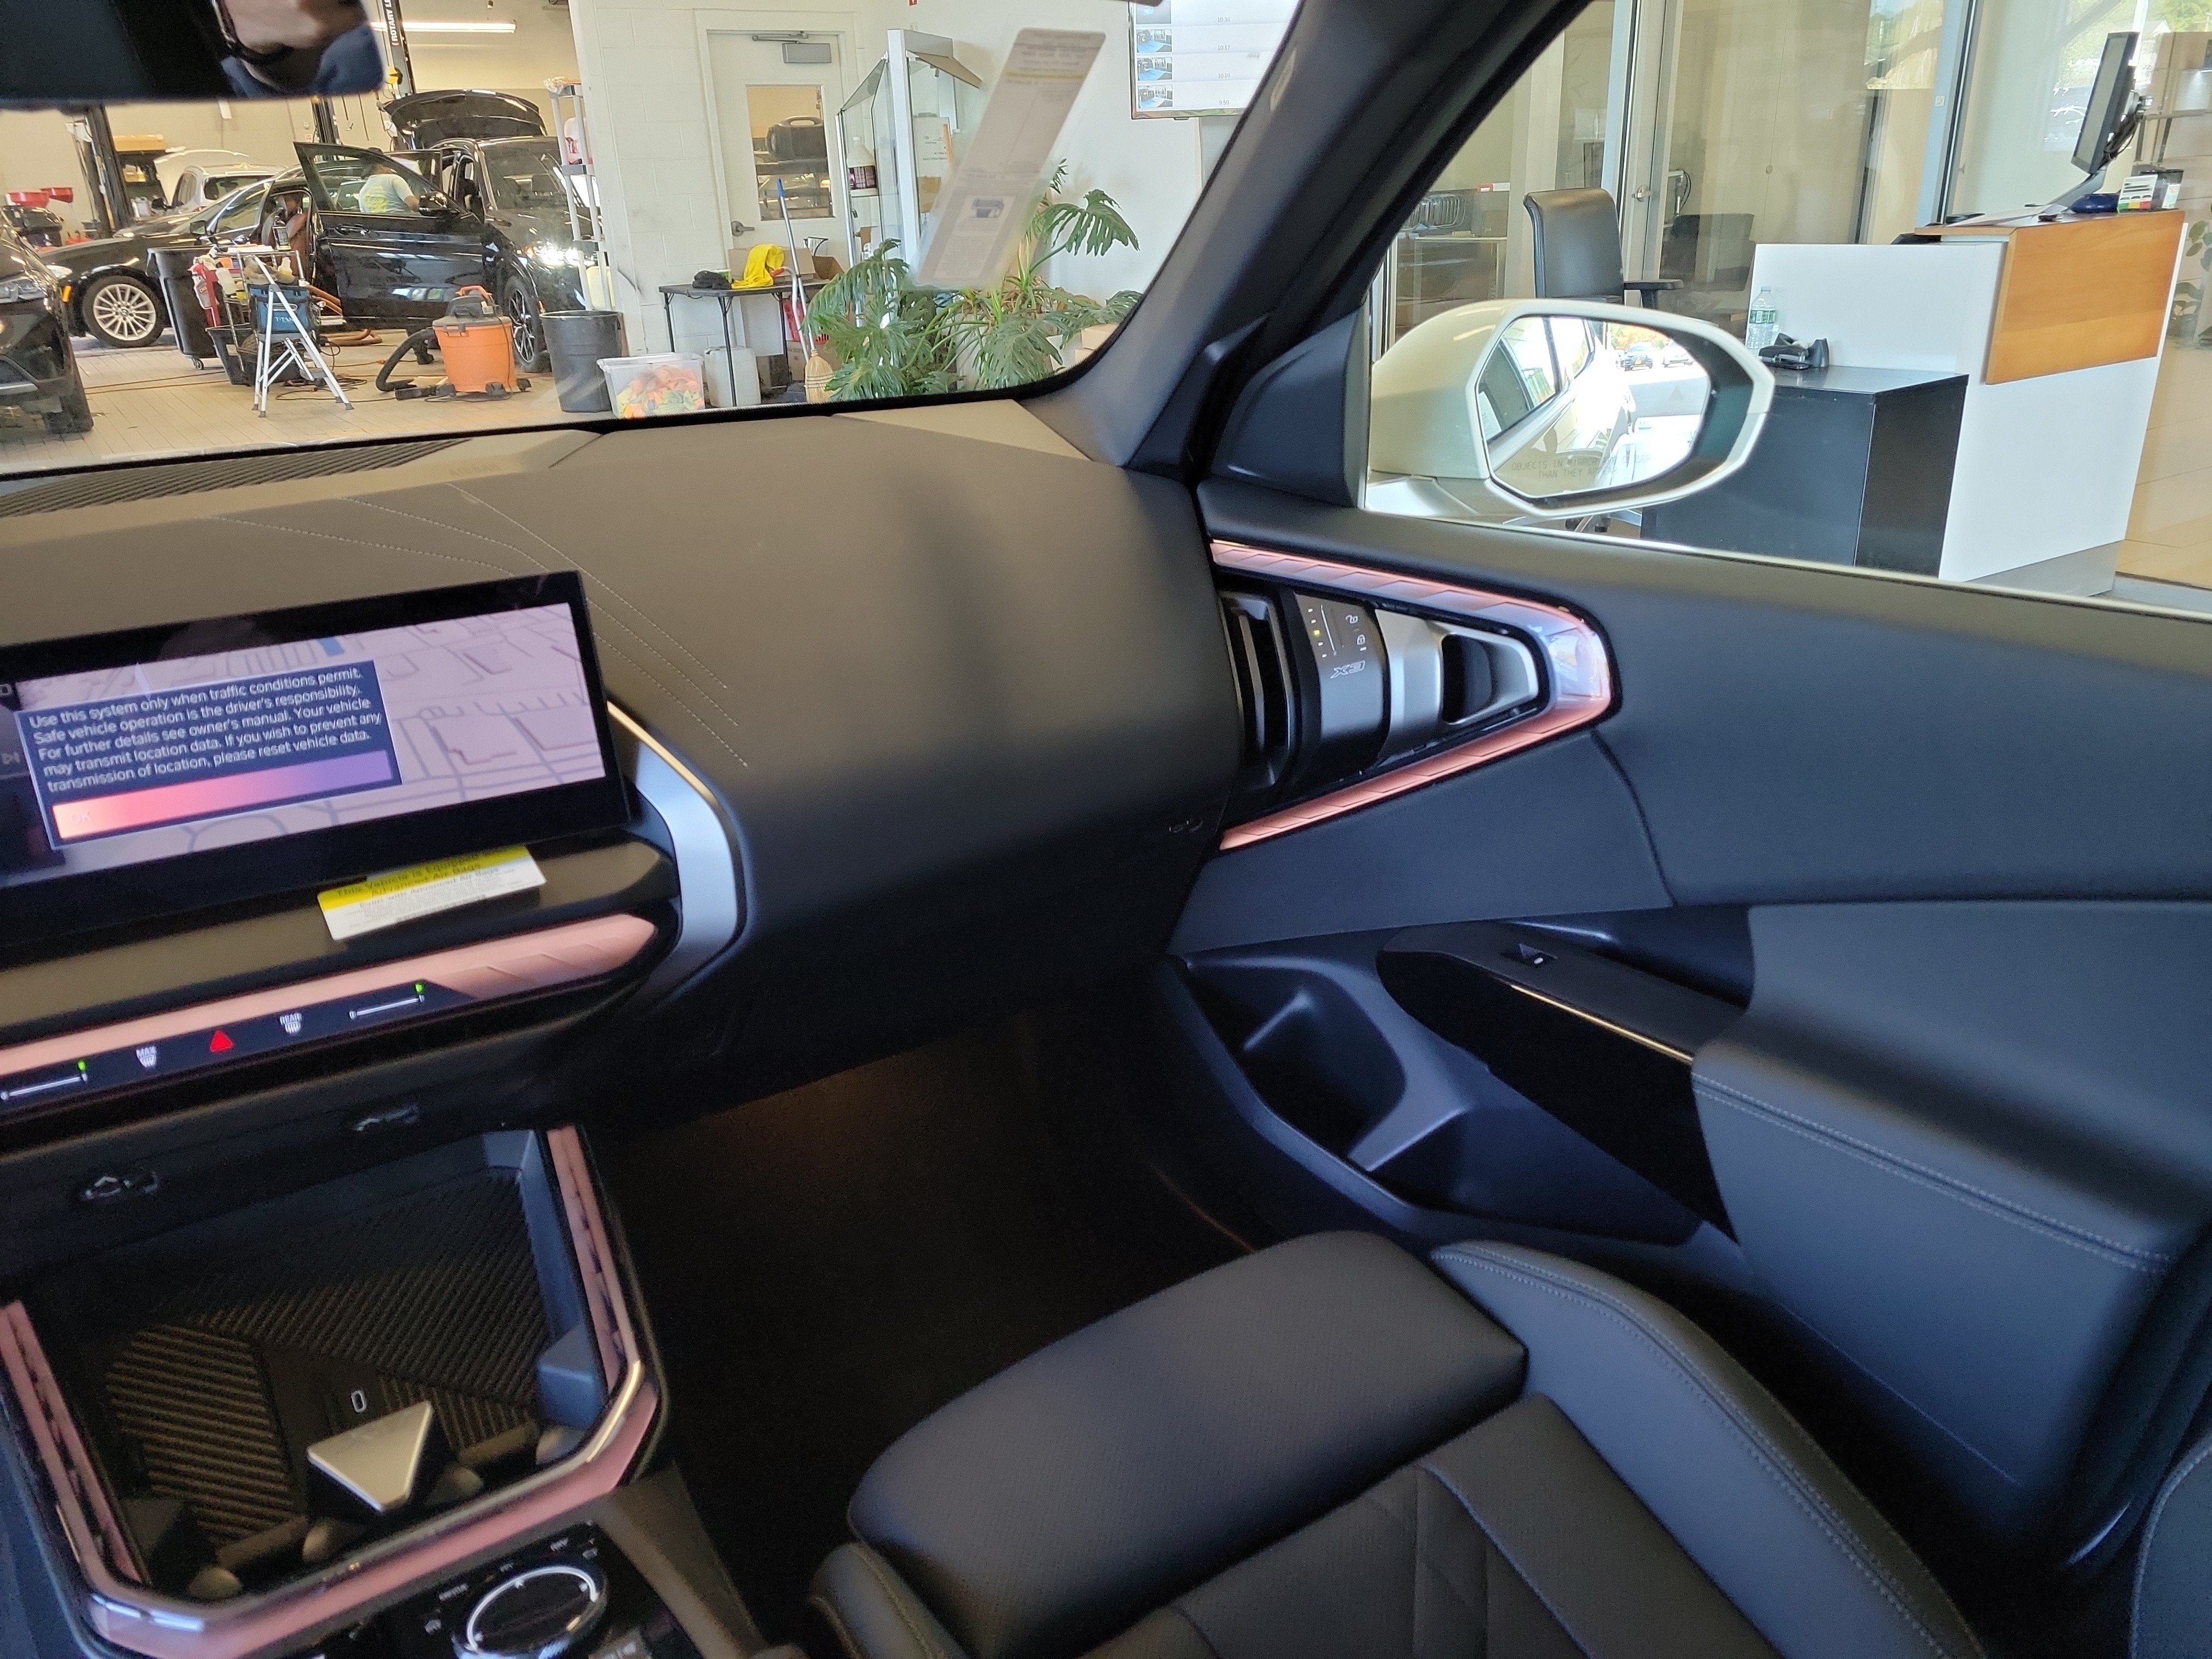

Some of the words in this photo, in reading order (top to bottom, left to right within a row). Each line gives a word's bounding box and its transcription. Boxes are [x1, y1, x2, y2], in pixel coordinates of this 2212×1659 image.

[386, 9, 398, 42] ROTARY
[1511, 460, 1548, 471] OBJECTS
[1539, 470, 1558, 478] THAN
[1564, 468, 1582, 477] THEY
[30, 715, 58, 729] Use
[60, 710, 87, 723] this
[89, 702, 138, 720] system
[140, 697, 168, 710] only
[171, 692, 207, 706] when
[209, 685, 246, 701] traffic
[250, 675, 315, 695] conditions
[318, 668, 362, 687] permit.
[34, 729, 66, 744] Safe
[68, 722, 117, 738] vehicle
[120, 711, 184, 731] operation
[187, 708, 199, 720] is
[201, 706, 223, 718] the
[225, 697, 274, 714] driver's
[275, 684, 362, 708] responsibility.
[38, 747, 62, 761] For
[65, 740, 111, 757] further
[115, 731, 159, 748] details
[162, 728, 186, 740] see
[189, 719, 240, 736] owner's
[241, 709, 291, 727] manual.
[293, 705, 325, 719] Your
[326, 697, 371, 713] vehicle
[43, 763, 72, 777] may
[75, 752, 132, 771] transmit
[134, 743, 188, 761] location
[190, 738, 222, 753] data.
[224, 734, 235, 747] If
[236, 732, 262, 748] you
[262, 725, 292, 741] wish
[293, 724, 307, 736] to
[309, 715, 357, 734] prevent
[359, 712, 382, 726] any
[47, 768, 136, 793] transmission
[138, 763, 152, 777] of
[154, 757, 211, 774] location,
[213, 749, 256, 767] please
[258, 741, 291, 758] reset
[292, 735, 337, 752] vehicle
[340, 730, 370, 743] data.
[70, 810, 92, 823] OK
